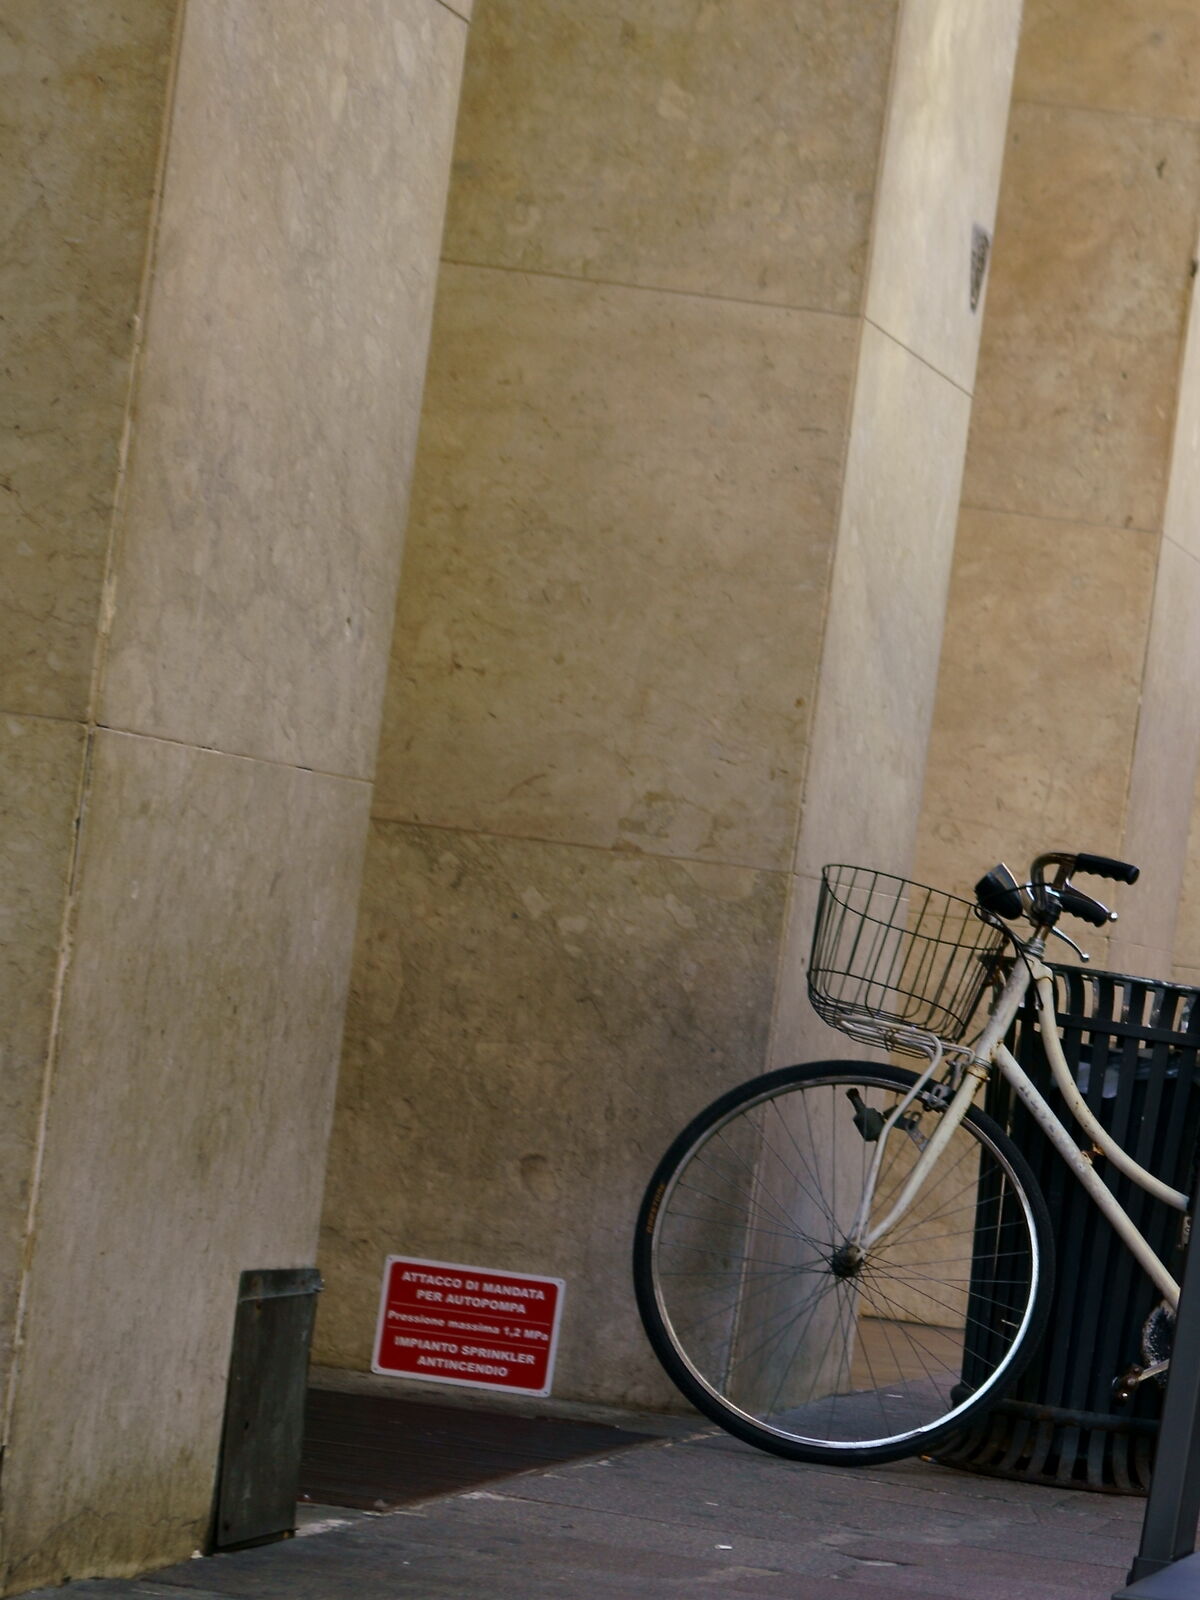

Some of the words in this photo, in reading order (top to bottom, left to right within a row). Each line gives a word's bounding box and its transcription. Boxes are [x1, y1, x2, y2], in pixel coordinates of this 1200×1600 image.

[401, 1271, 461, 1289] ATTACCO
[465, 1280, 479, 1292] DI
[482, 1282, 545, 1301] MANDATA
[416, 1289, 443, 1303] PER
[445, 1292, 527, 1315] AUTOPOMPA
[388, 1309, 445, 1327] Pressione
[447, 1319, 500, 1335] massima
[503, 1326, 522, 1339] 1,2
[523, 1329, 549, 1341] MPa
[394, 1336, 459, 1354] IMPIANTO
[461, 1345, 536, 1365] SPRINKLER
[417, 1355, 509, 1377] ANTINCENDIO
